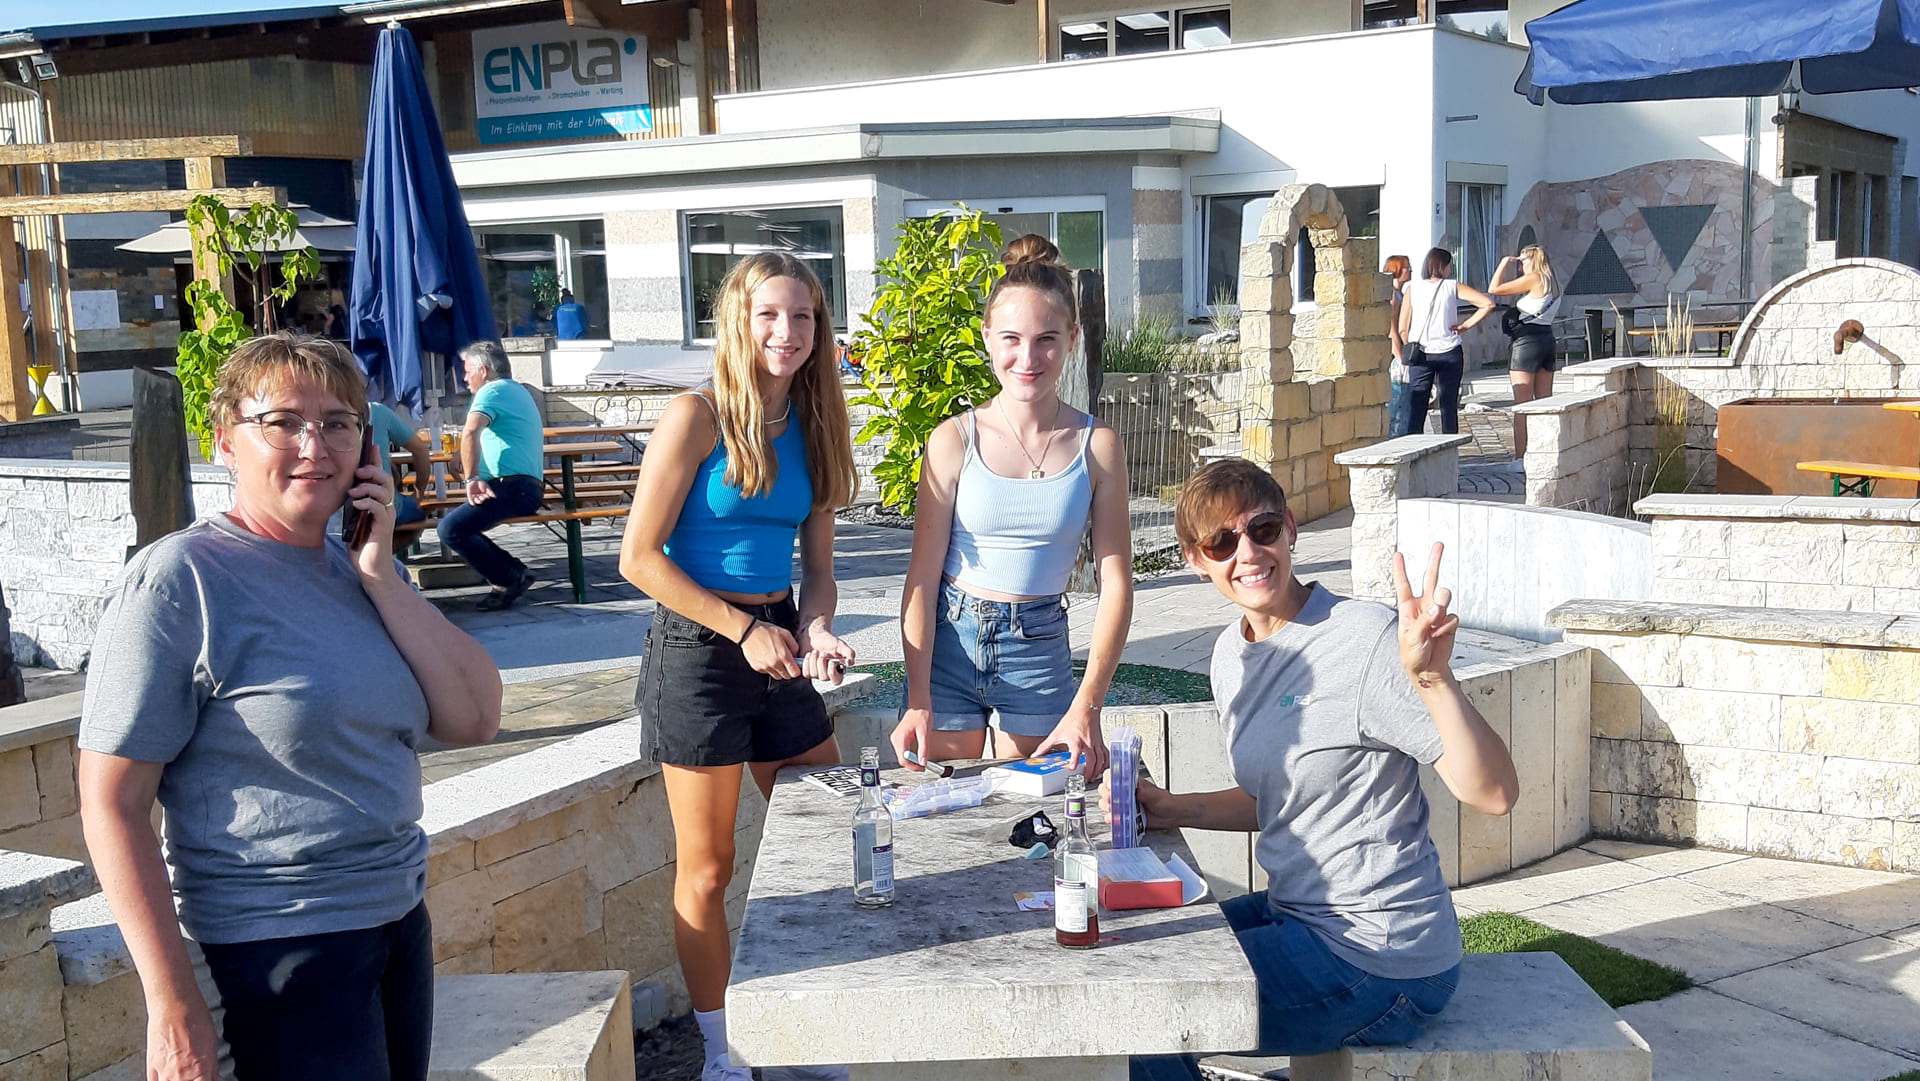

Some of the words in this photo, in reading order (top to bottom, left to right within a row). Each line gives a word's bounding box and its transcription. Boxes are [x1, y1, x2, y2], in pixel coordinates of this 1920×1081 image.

[600, 86, 624, 96] Wartung
[490, 124, 502, 135] Im
[507, 122, 542, 135] Einklang
[547, 120, 563, 130] mit
[568, 116, 584, 129] der
[587, 114, 625, 127] Umwelt
